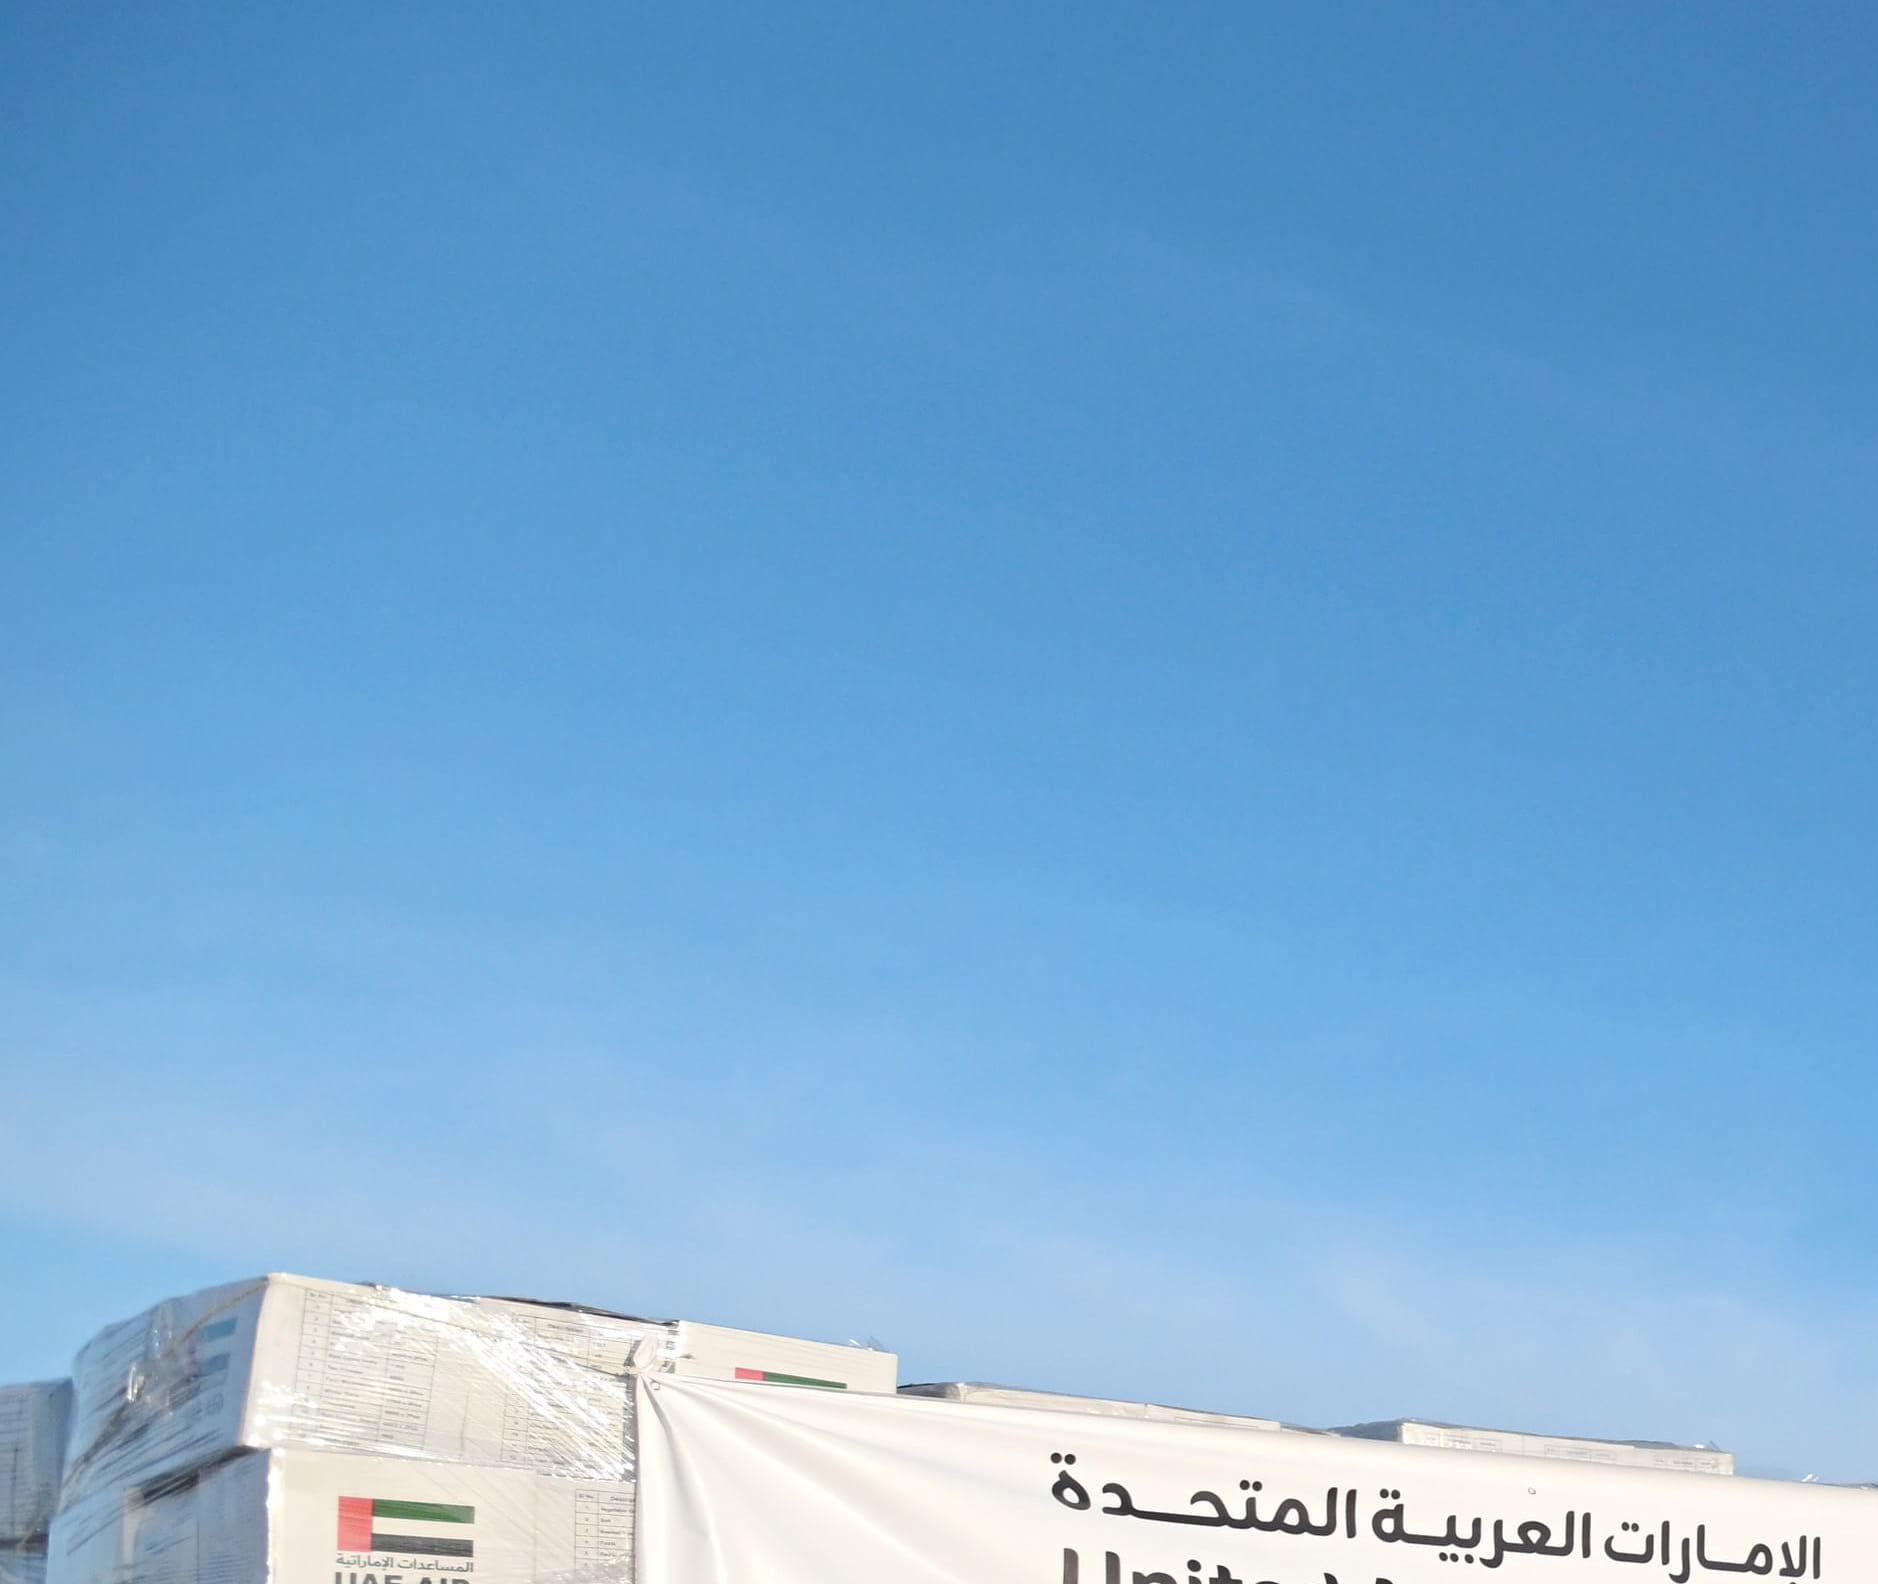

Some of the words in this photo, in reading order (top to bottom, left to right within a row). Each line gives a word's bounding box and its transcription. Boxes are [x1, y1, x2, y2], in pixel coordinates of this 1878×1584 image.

[1050, 1451, 1356, 1537] المتحدة
[1372, 1489, 1590, 1567] العربية
[336, 1553, 393, 1571] الإماراتية
[398, 1559, 474, 1572] المساعدات
